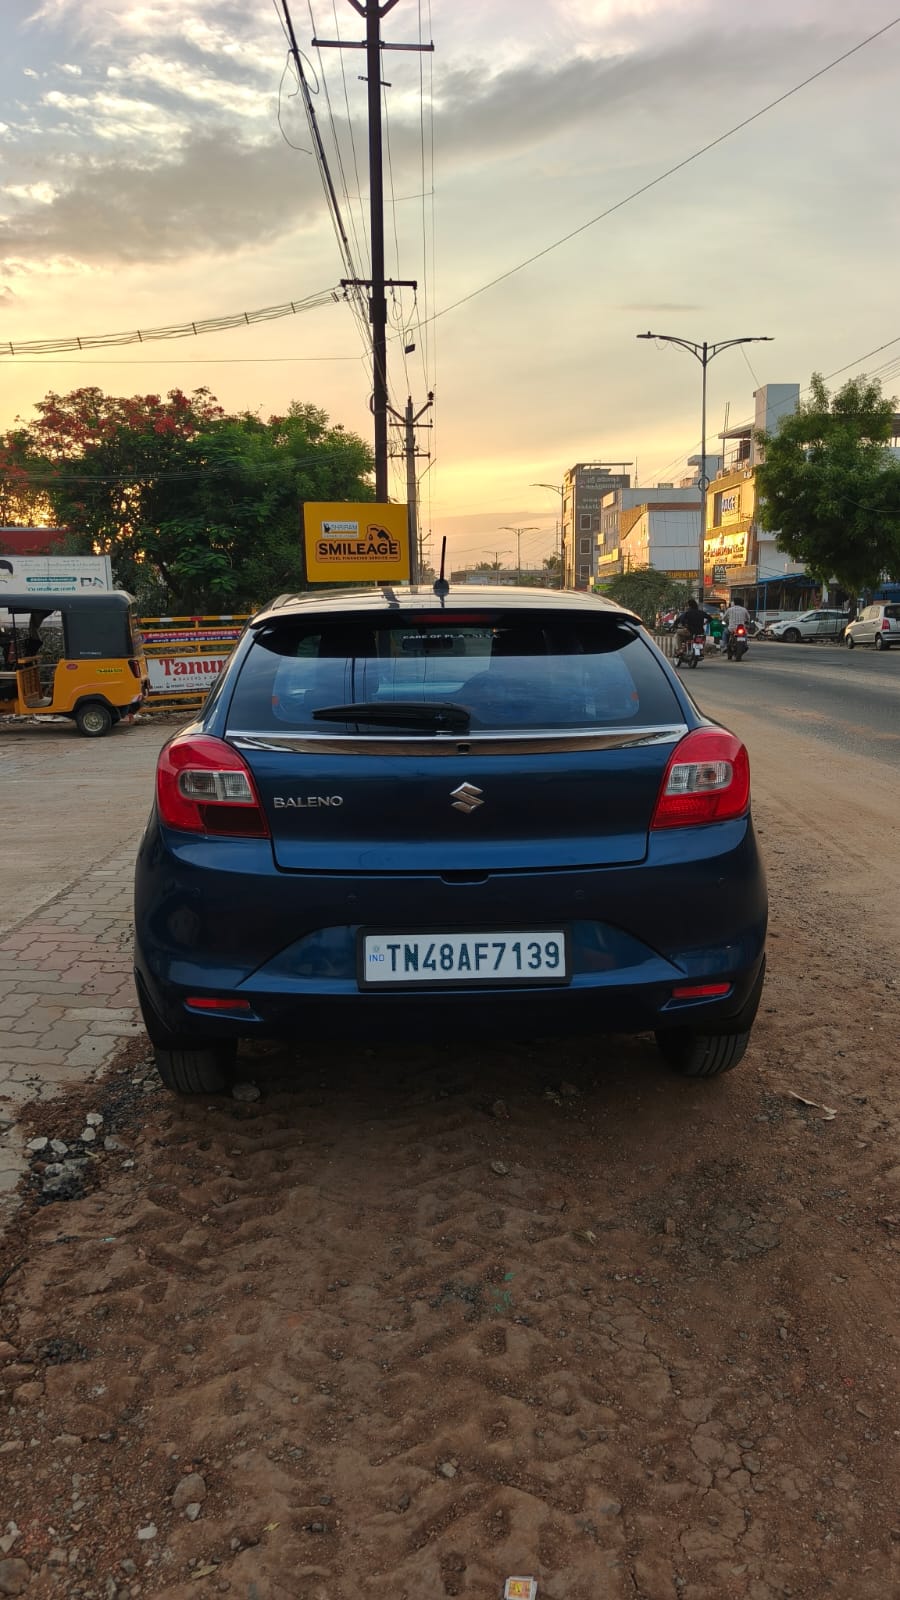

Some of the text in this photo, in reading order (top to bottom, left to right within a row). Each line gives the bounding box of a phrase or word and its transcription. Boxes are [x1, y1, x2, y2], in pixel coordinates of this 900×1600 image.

[319, 542, 398, 555] SMILEAGE
[273, 795, 343, 809] BALENO
[369, 954, 385, 962] IND
[386, 941, 560, 972] TN48AF7139
